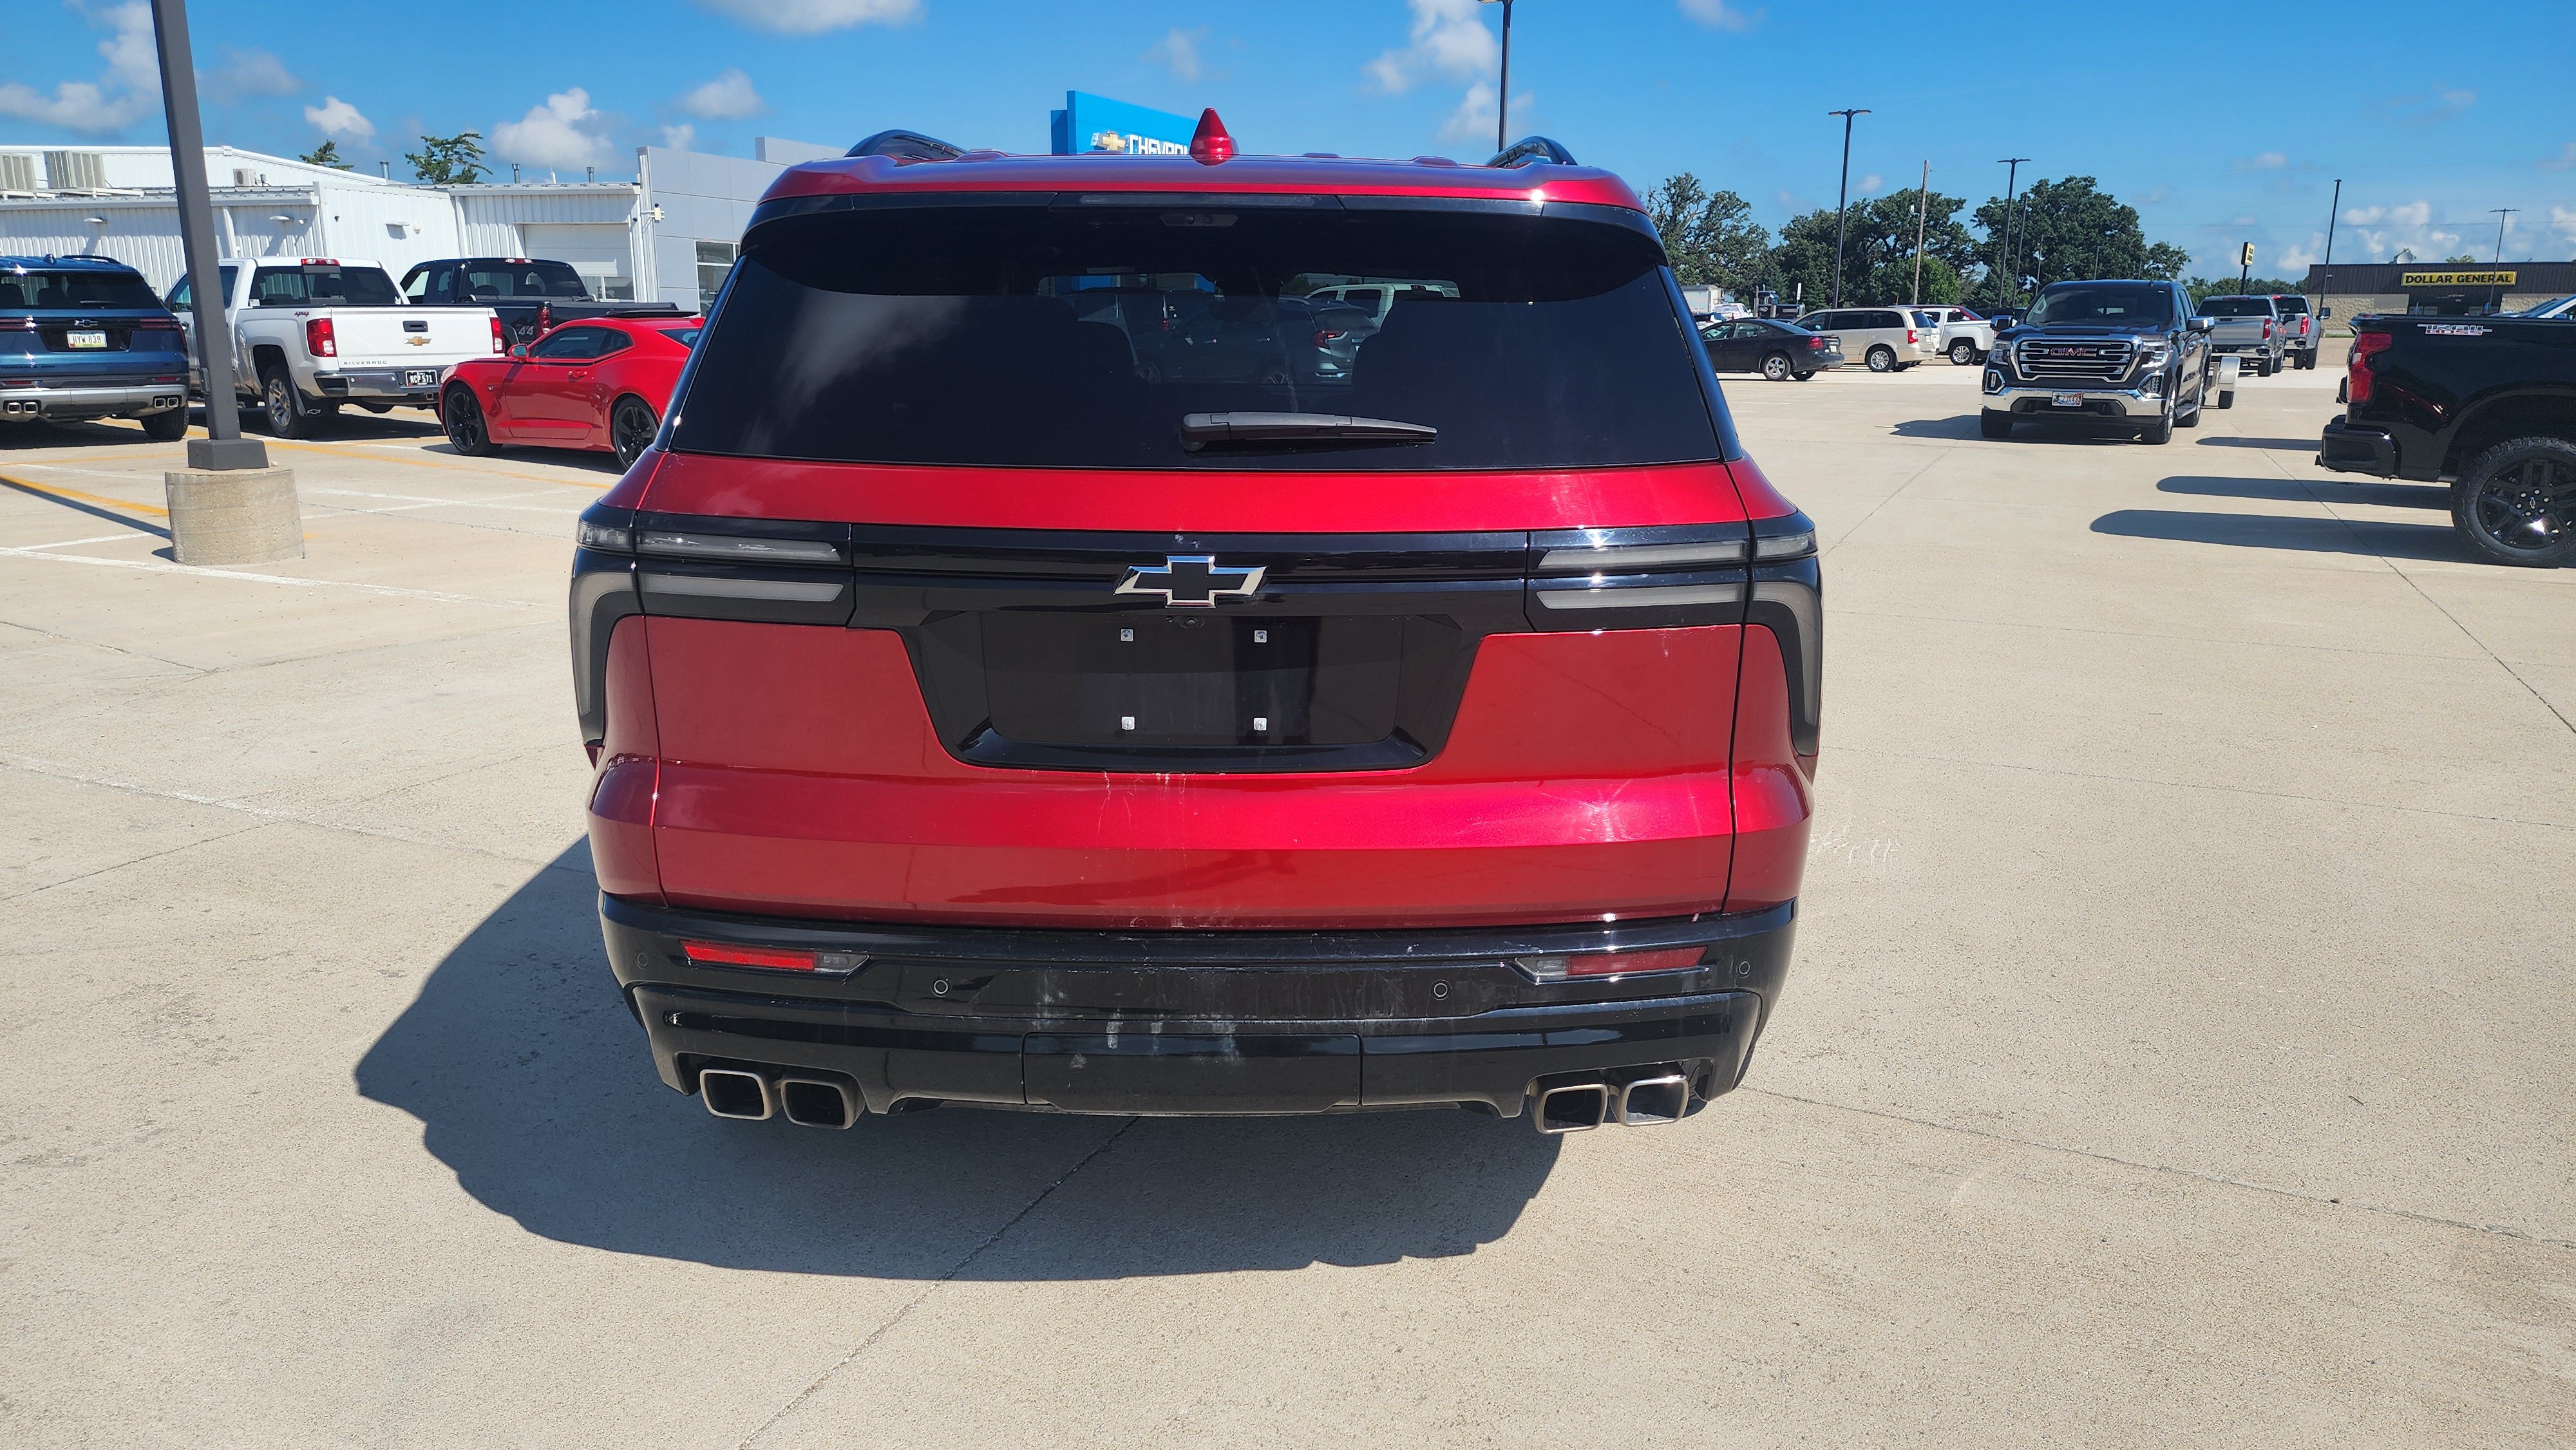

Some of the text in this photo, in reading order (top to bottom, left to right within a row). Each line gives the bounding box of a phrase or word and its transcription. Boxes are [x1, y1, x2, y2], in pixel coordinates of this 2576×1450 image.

[2405, 274, 2511, 283] DOLLAR GENERAL
[2050, 347, 2098, 357] GMC
